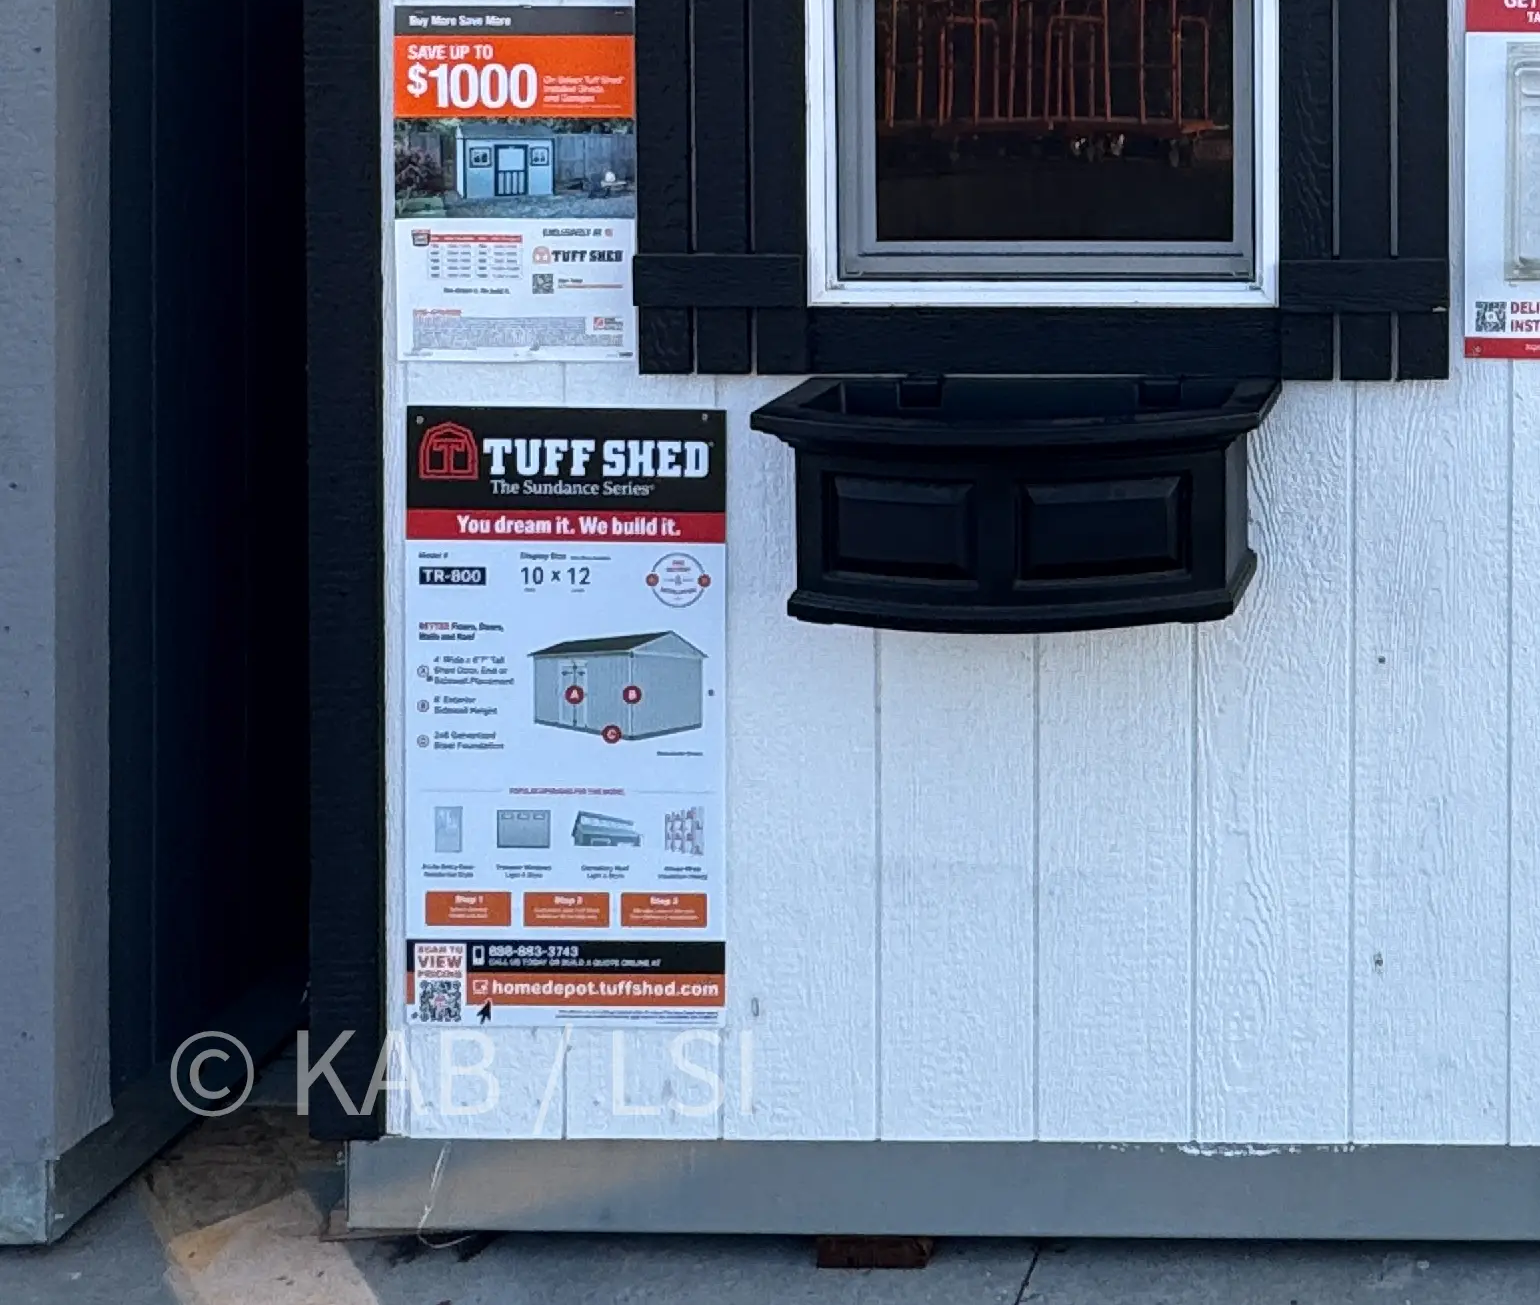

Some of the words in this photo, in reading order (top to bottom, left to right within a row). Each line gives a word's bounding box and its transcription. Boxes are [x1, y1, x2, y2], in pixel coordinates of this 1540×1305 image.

[408, 15, 429, 28] Buy
[430, 15, 457, 26] More
[458, 15, 483, 26] Save
[485, 15, 512, 26] More
[408, 45, 447, 59] SAVE
[450, 45, 470, 59] UP
[474, 45, 494, 59] TO
[407, 62, 538, 109] $1000
[552, 250, 588, 262] TUFF
[589, 250, 624, 262] SHED
[483, 438, 596, 477] TUFF
[602, 440, 710, 478] SHED
[490, 479, 520, 495] The
[522, 480, 600, 495] Sundance
[457, 514, 487, 533] You
[494, 515, 552, 534] dream
[555, 516, 576, 535] it.
[578, 516, 610, 535] We
[612, 516, 658, 535] build
[661, 517, 681, 536] it.
[423, 570, 482, 583] TR-800
[520, 566, 544, 585] 10
[550, 570, 562, 582] x
[568, 567, 591, 585] 12
[418, 956, 462, 968] VIEW
[492, 980, 719, 998] homedepot.tuffshed.com
